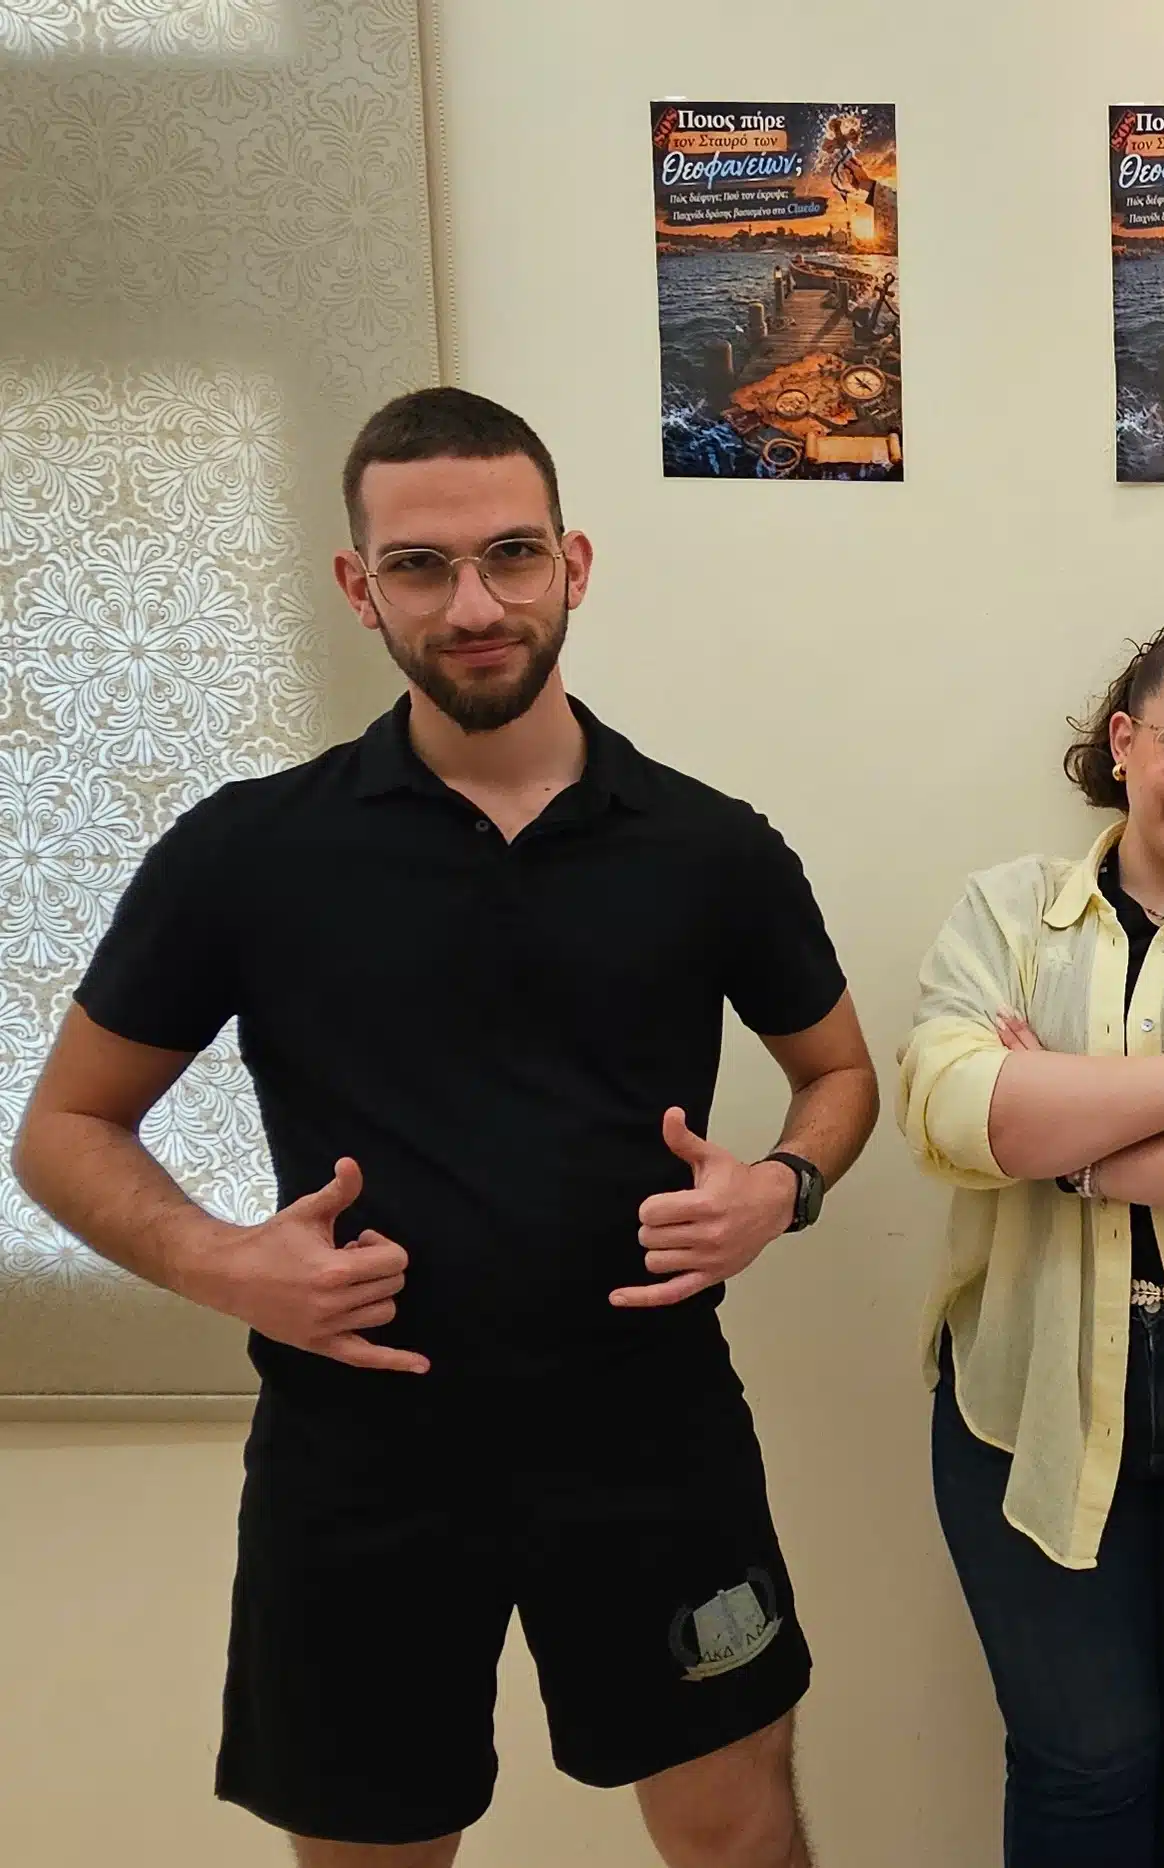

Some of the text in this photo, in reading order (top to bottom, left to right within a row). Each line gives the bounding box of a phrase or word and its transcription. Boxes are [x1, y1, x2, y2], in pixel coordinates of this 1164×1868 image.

[678, 110, 785, 132] Ποιος πήρε
[672, 134, 778, 150] τον Σταυρό των
[1131, 140, 1154, 152] τον
[662, 151, 803, 189] Θεοφανείων;
